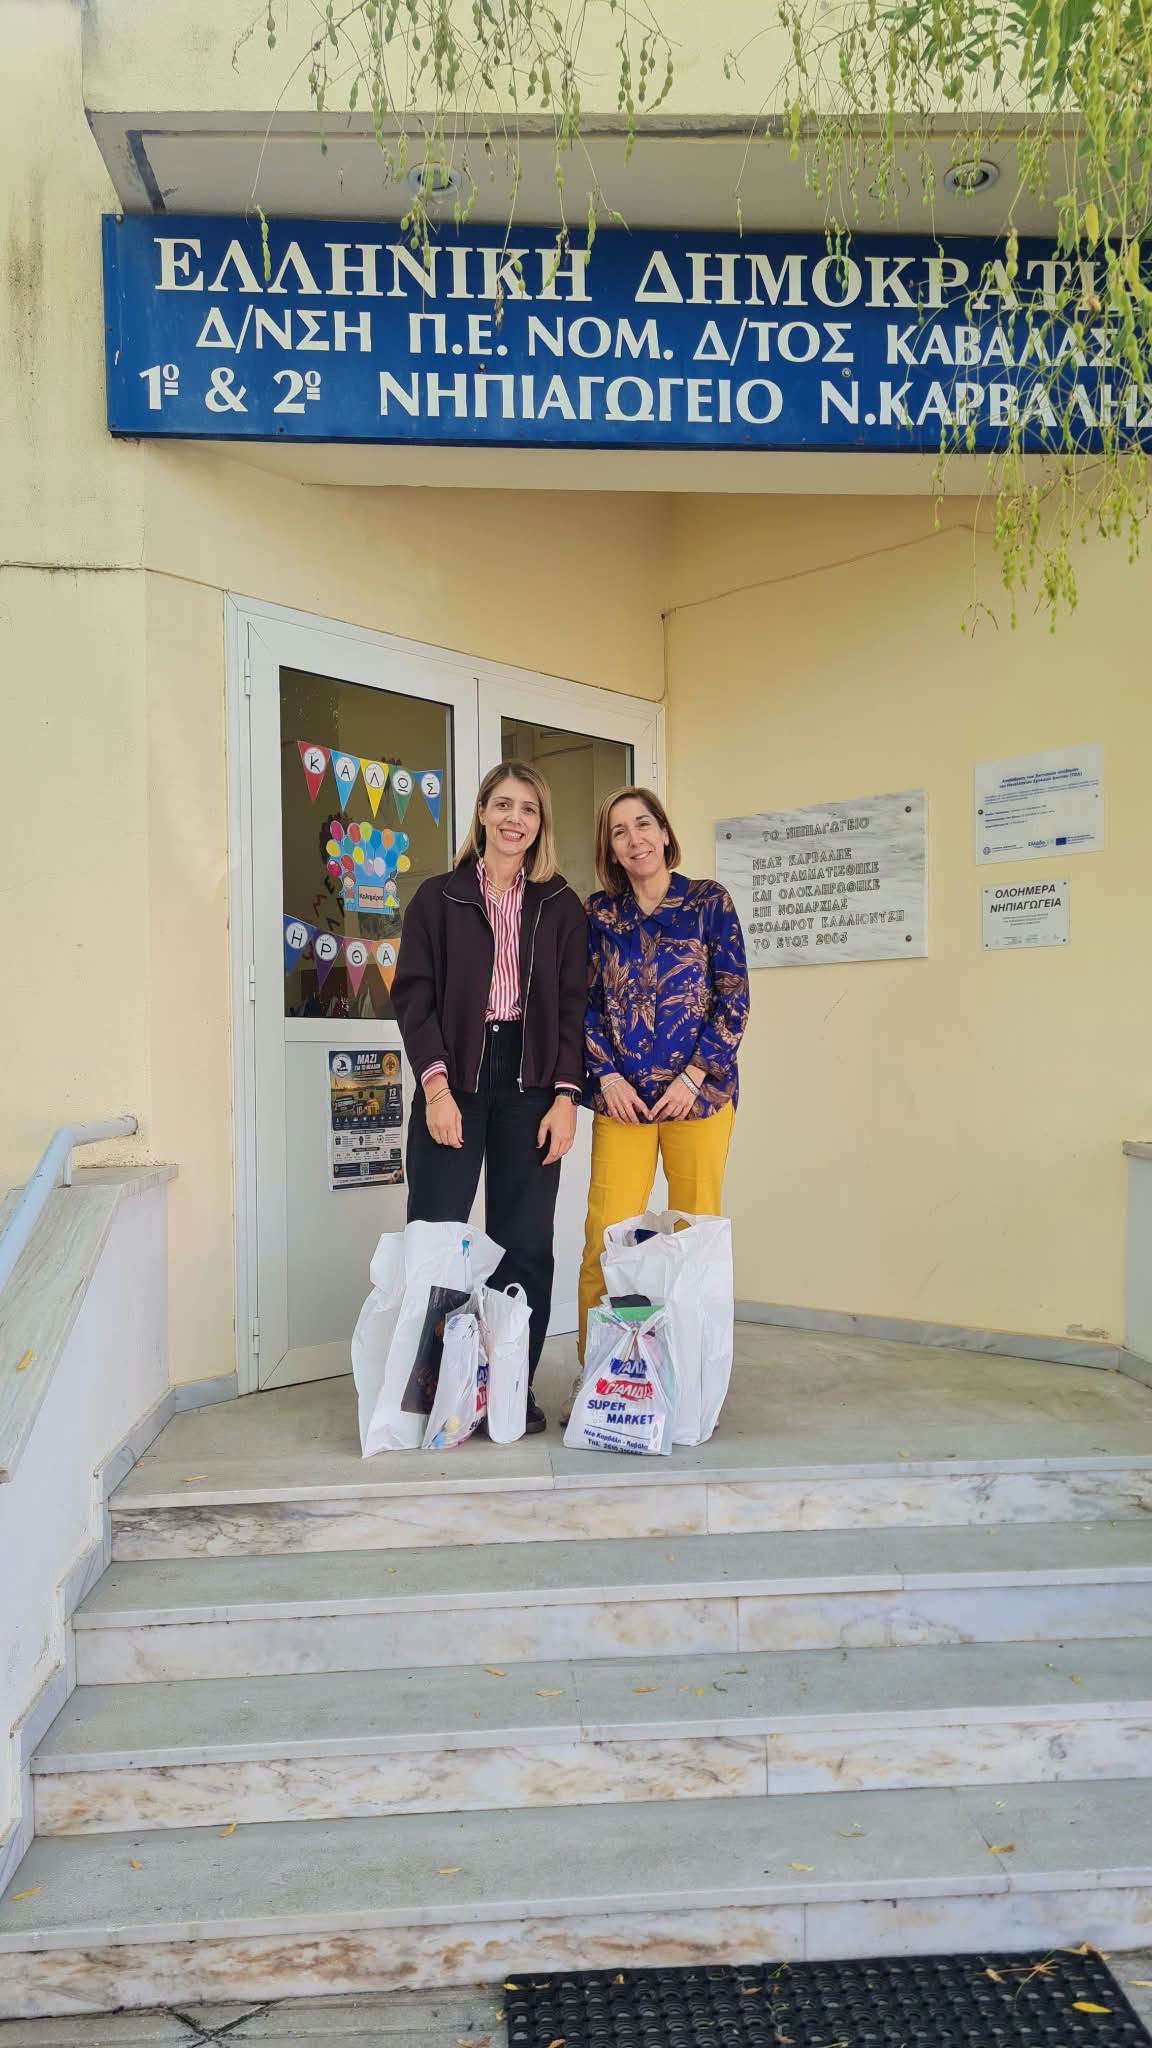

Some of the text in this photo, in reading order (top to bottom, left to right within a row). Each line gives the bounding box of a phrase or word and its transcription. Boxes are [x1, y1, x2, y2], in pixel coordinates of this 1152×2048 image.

[153, 237, 593, 302] ΕΛΛΗΝΙΚΗ
[195, 304, 1121, 368] Δ/ΝΣΗ Π.Ε. ΝΟΜ. Δ/ΤΟΣ ΚΑΒΑΛΑΣ
[205, 366, 249, 414] &
[379, 371, 784, 424] ΝΗΠΙΑΓΩΓΕΙΟ
[761, 830, 780, 842] ΤΟ
[752, 848, 852, 870] ΝΕΑΣ ΚΑΡΒΑΛΗΣ
[752, 861, 880, 886] ΠΡΟΓΡΑΜΜΑΤΙΣΘΗΚΕ
[752, 878, 881, 903] ΚΑΙ ΟΛΟΚΛΗΡΩΘΗΚΕ
[995, 883, 1056, 899] ΟΛΟΗΜΕΡΑ
[752, 898, 848, 918] ΕΠΙ ΝΟΜΑΡΧΙΑΣ
[989, 897, 1062, 913] ΝΗΠΙΑΓΩΓΕΙΑ
[748, 917, 815, 934] ΘΕΟΔΩΡΟΥ
[753, 938, 771, 950] ΤΟ
[776, 934, 809, 949] ΕΤΟΣ
[606, 1413, 655, 1425] MARKET
